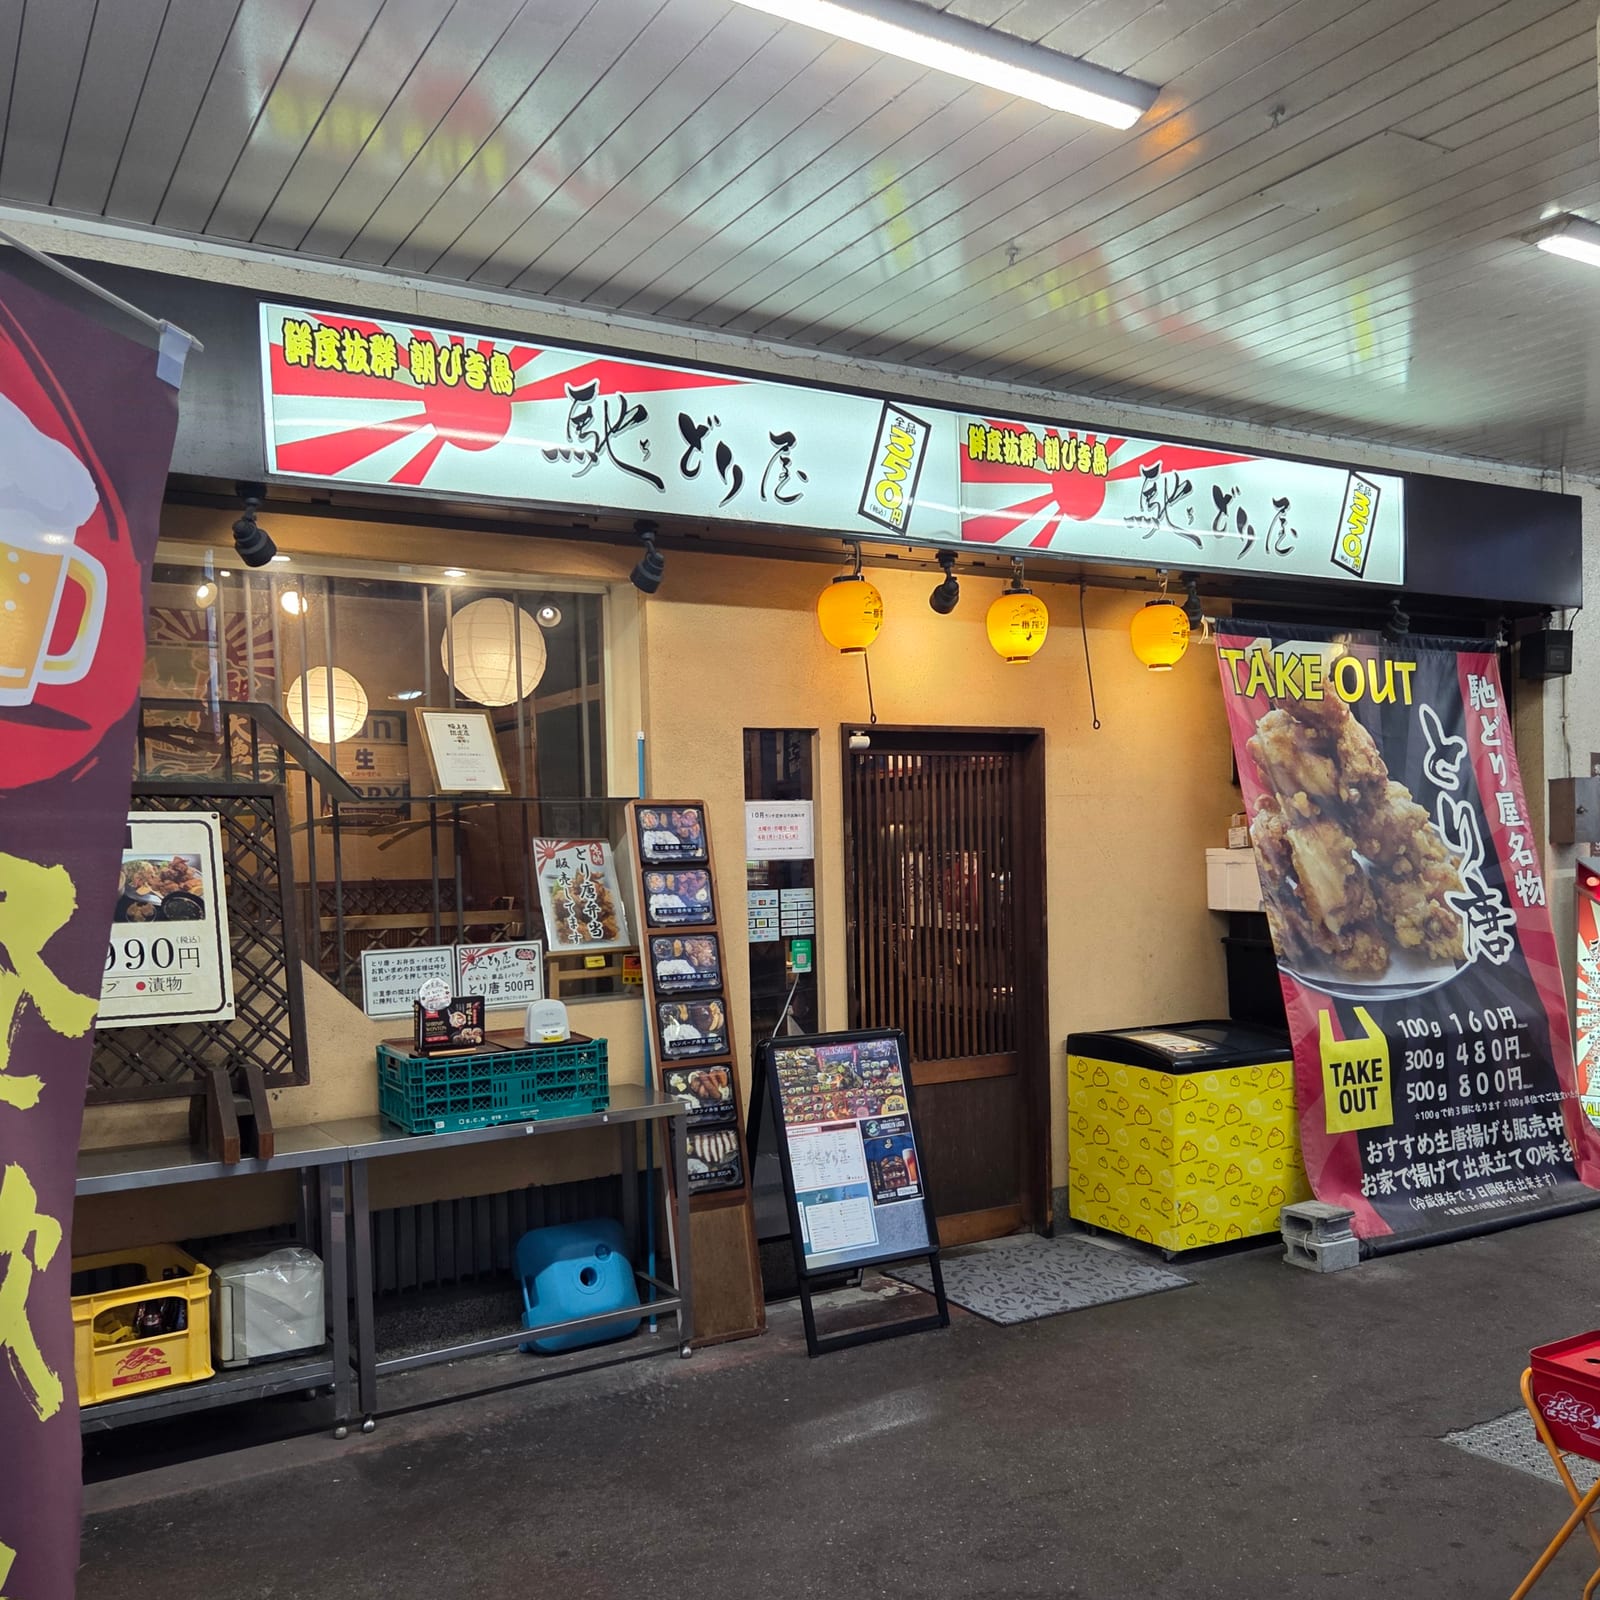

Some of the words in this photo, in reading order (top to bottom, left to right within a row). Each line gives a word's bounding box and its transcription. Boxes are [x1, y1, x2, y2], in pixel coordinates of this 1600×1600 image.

[282, 318, 399, 378] 鮮度抜群
[408, 338, 515, 396] 朝びき鳥
[895, 417, 916, 435] 全品
[967, 424, 1038, 468] 鮮度抜群
[1042, 434, 1109, 477] 朝びき鳥
[1219, 648, 1325, 701] TAKE
[1334, 656, 1416, 705] OUT
[355, 748, 376, 770] 生
[1467, 673, 1547, 907] 馳どり屋名物
[555, 858, 582, 945] 販売してます
[576, 848, 603, 938] とり唐弁当
[148, 975, 182, 993] 漬物
[468, 982, 500, 995] とり唐
[504, 979, 534, 992] 500円
[1396, 1017, 1442, 1039] 100g
[1449, 1006, 1518, 1034] 160円
[1405, 1048, 1445, 1071] 300g
[1456, 1035, 1521, 1066] 480円
[1330, 1058, 1384, 1088] TAKE
[1406, 1080, 1447, 1103] 500g
[1458, 1066, 1523, 1098] 800円
[1339, 1087, 1378, 1114] OUT
[1408, 1172, 1558, 1211] (冷蔵保存で3日間保存出来ます)
